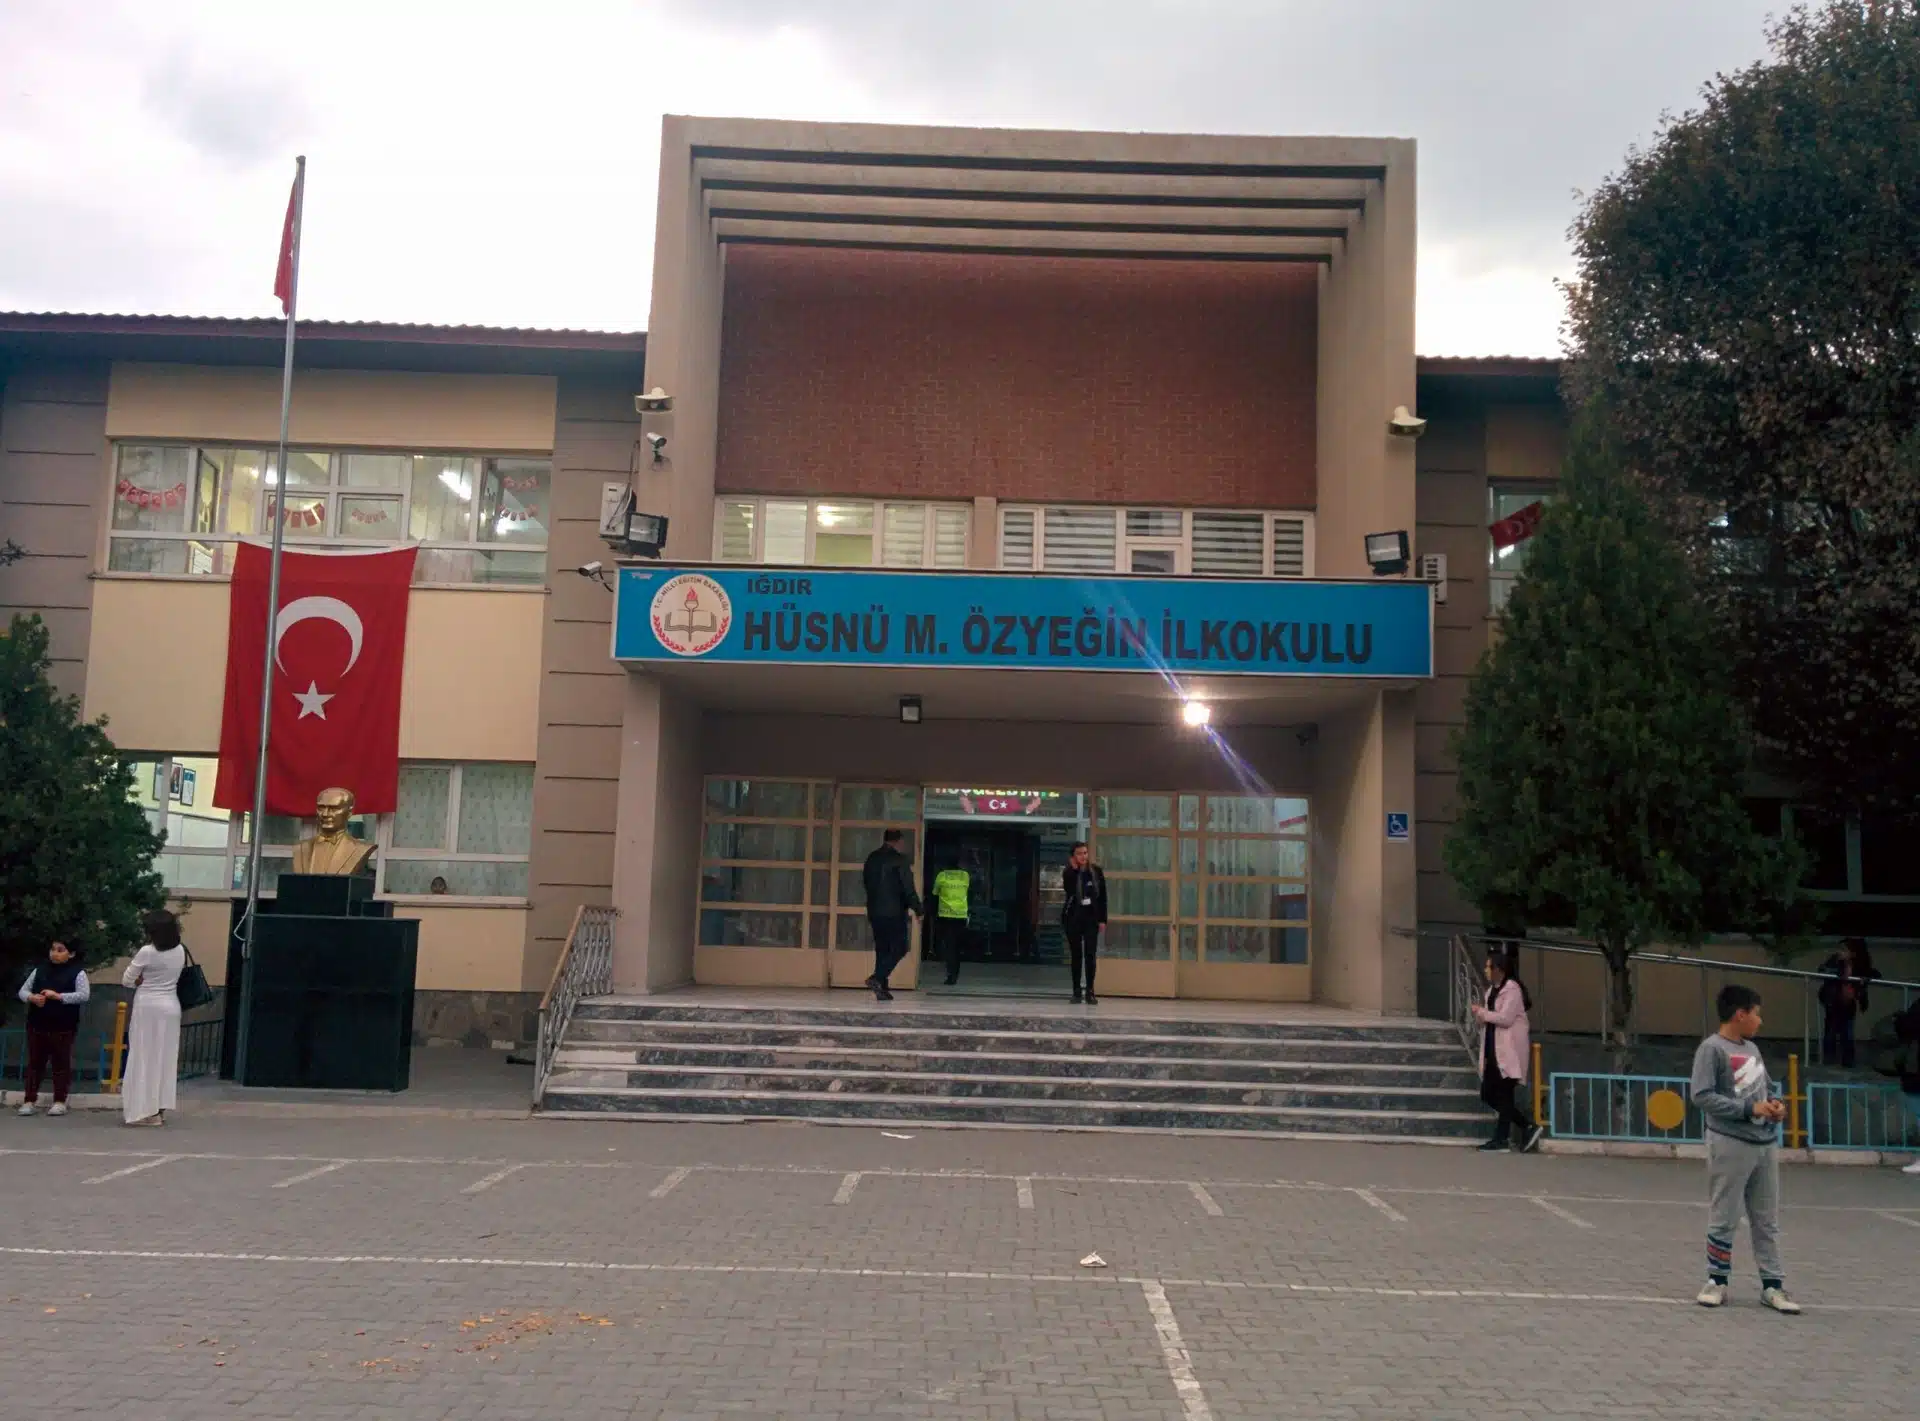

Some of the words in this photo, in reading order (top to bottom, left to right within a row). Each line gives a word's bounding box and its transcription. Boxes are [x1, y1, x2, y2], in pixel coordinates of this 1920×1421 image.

[748, 574, 812, 595] IĞDIR
[744, 602, 890, 654] HÜSNÜ
[903, 613, 949, 655] M.
[962, 605, 1147, 658] ÖZYEĞİN
[1162, 607, 1373, 665] İLKOKULU
